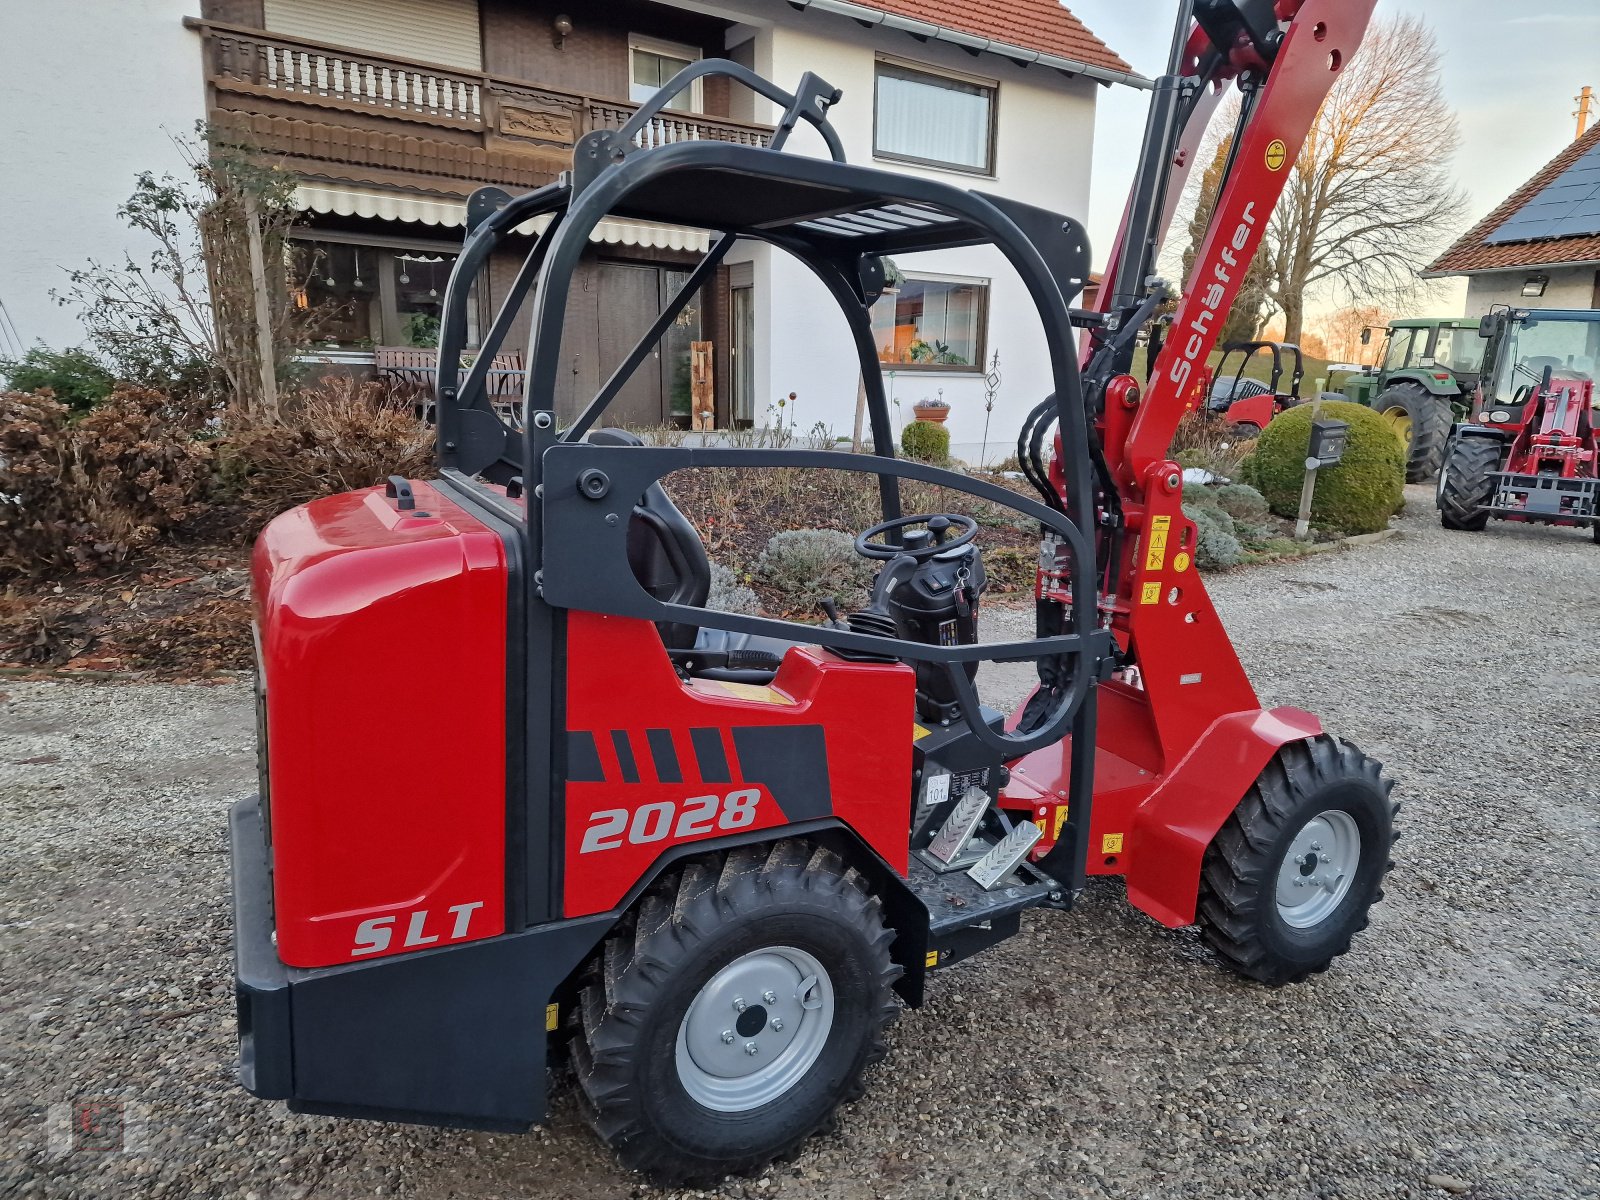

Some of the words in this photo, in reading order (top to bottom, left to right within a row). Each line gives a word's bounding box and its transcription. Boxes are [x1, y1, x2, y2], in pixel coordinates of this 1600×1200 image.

[1169, 201, 1255, 399] Schäffer
[579, 788, 761, 854] 2028
[351, 901, 484, 957] SLT
